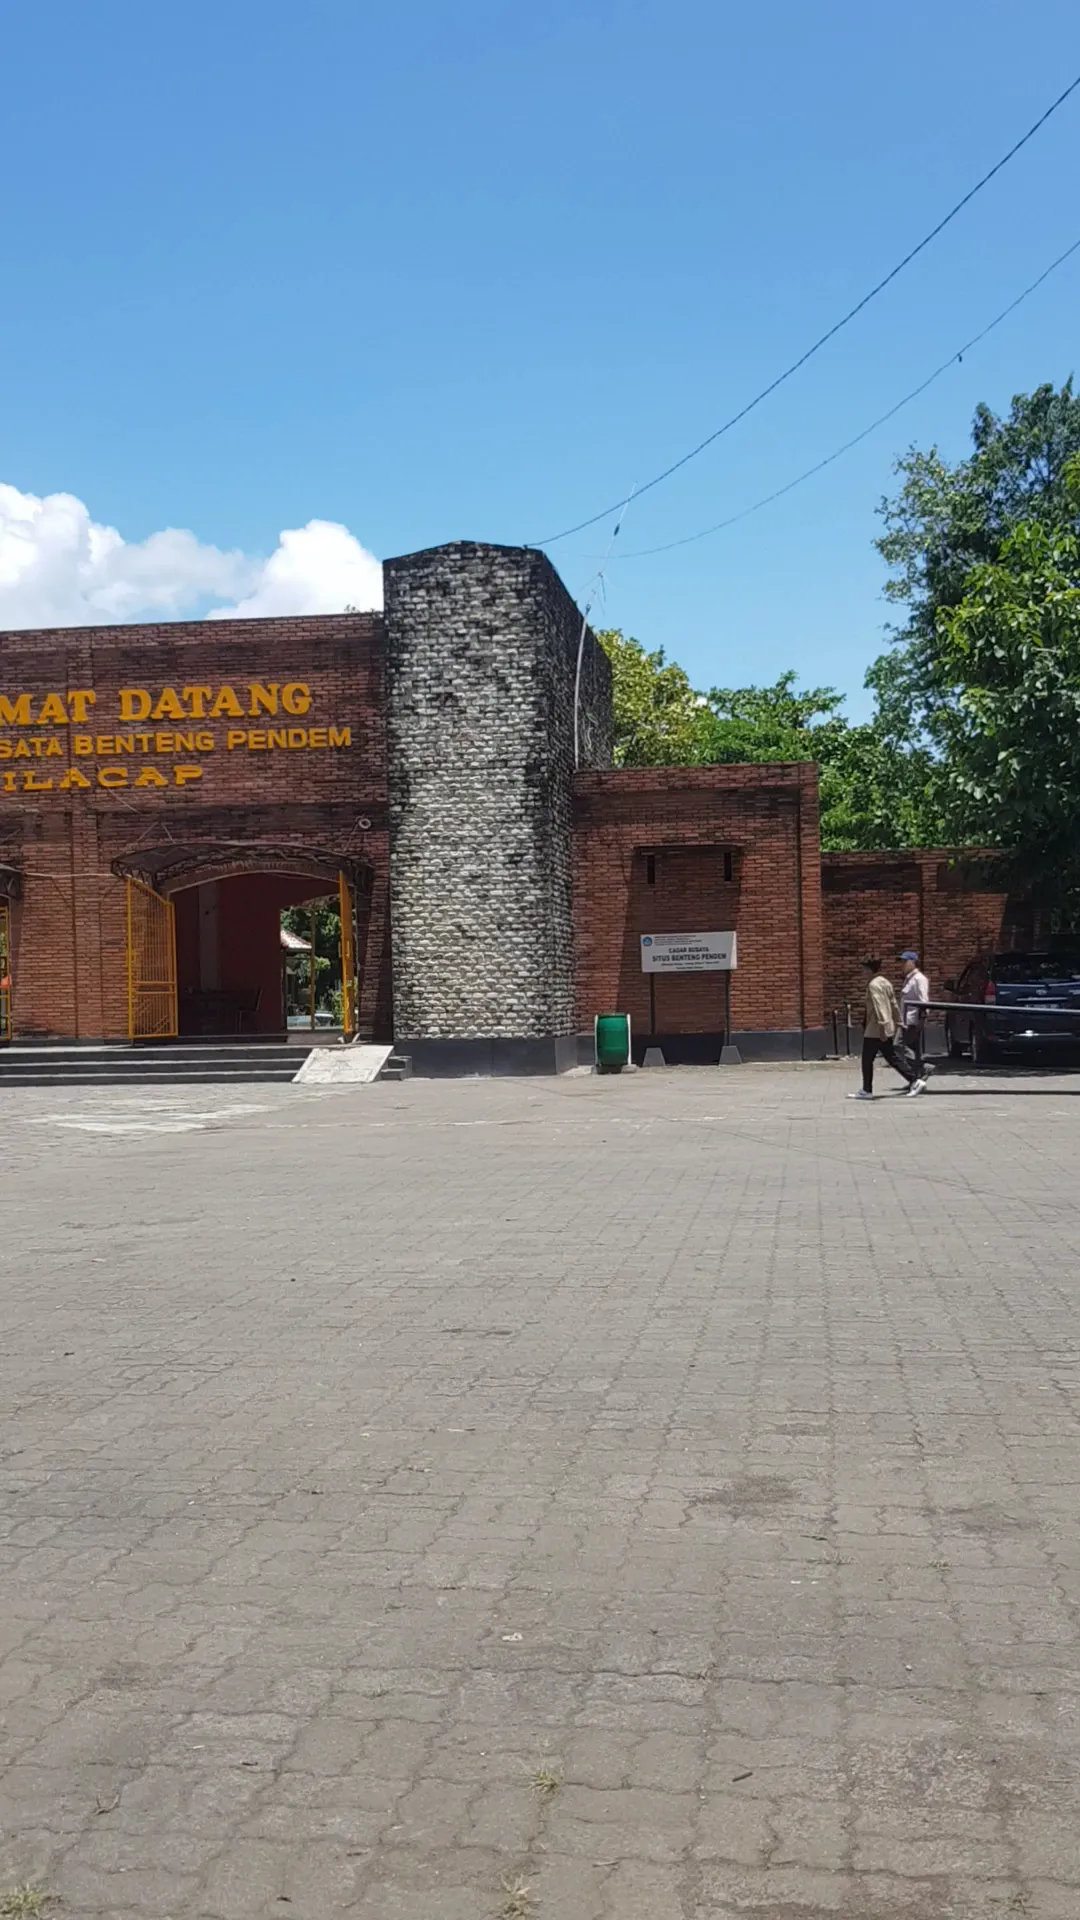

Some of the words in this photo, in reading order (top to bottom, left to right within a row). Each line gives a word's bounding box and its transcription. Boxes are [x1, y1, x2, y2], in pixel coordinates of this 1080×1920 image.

[119, 683, 312, 720] DATANG
[74, 731, 214, 756] BENTENG
[227, 727, 351, 750] PENDEM
[4, 765, 203, 791] ILACAP
